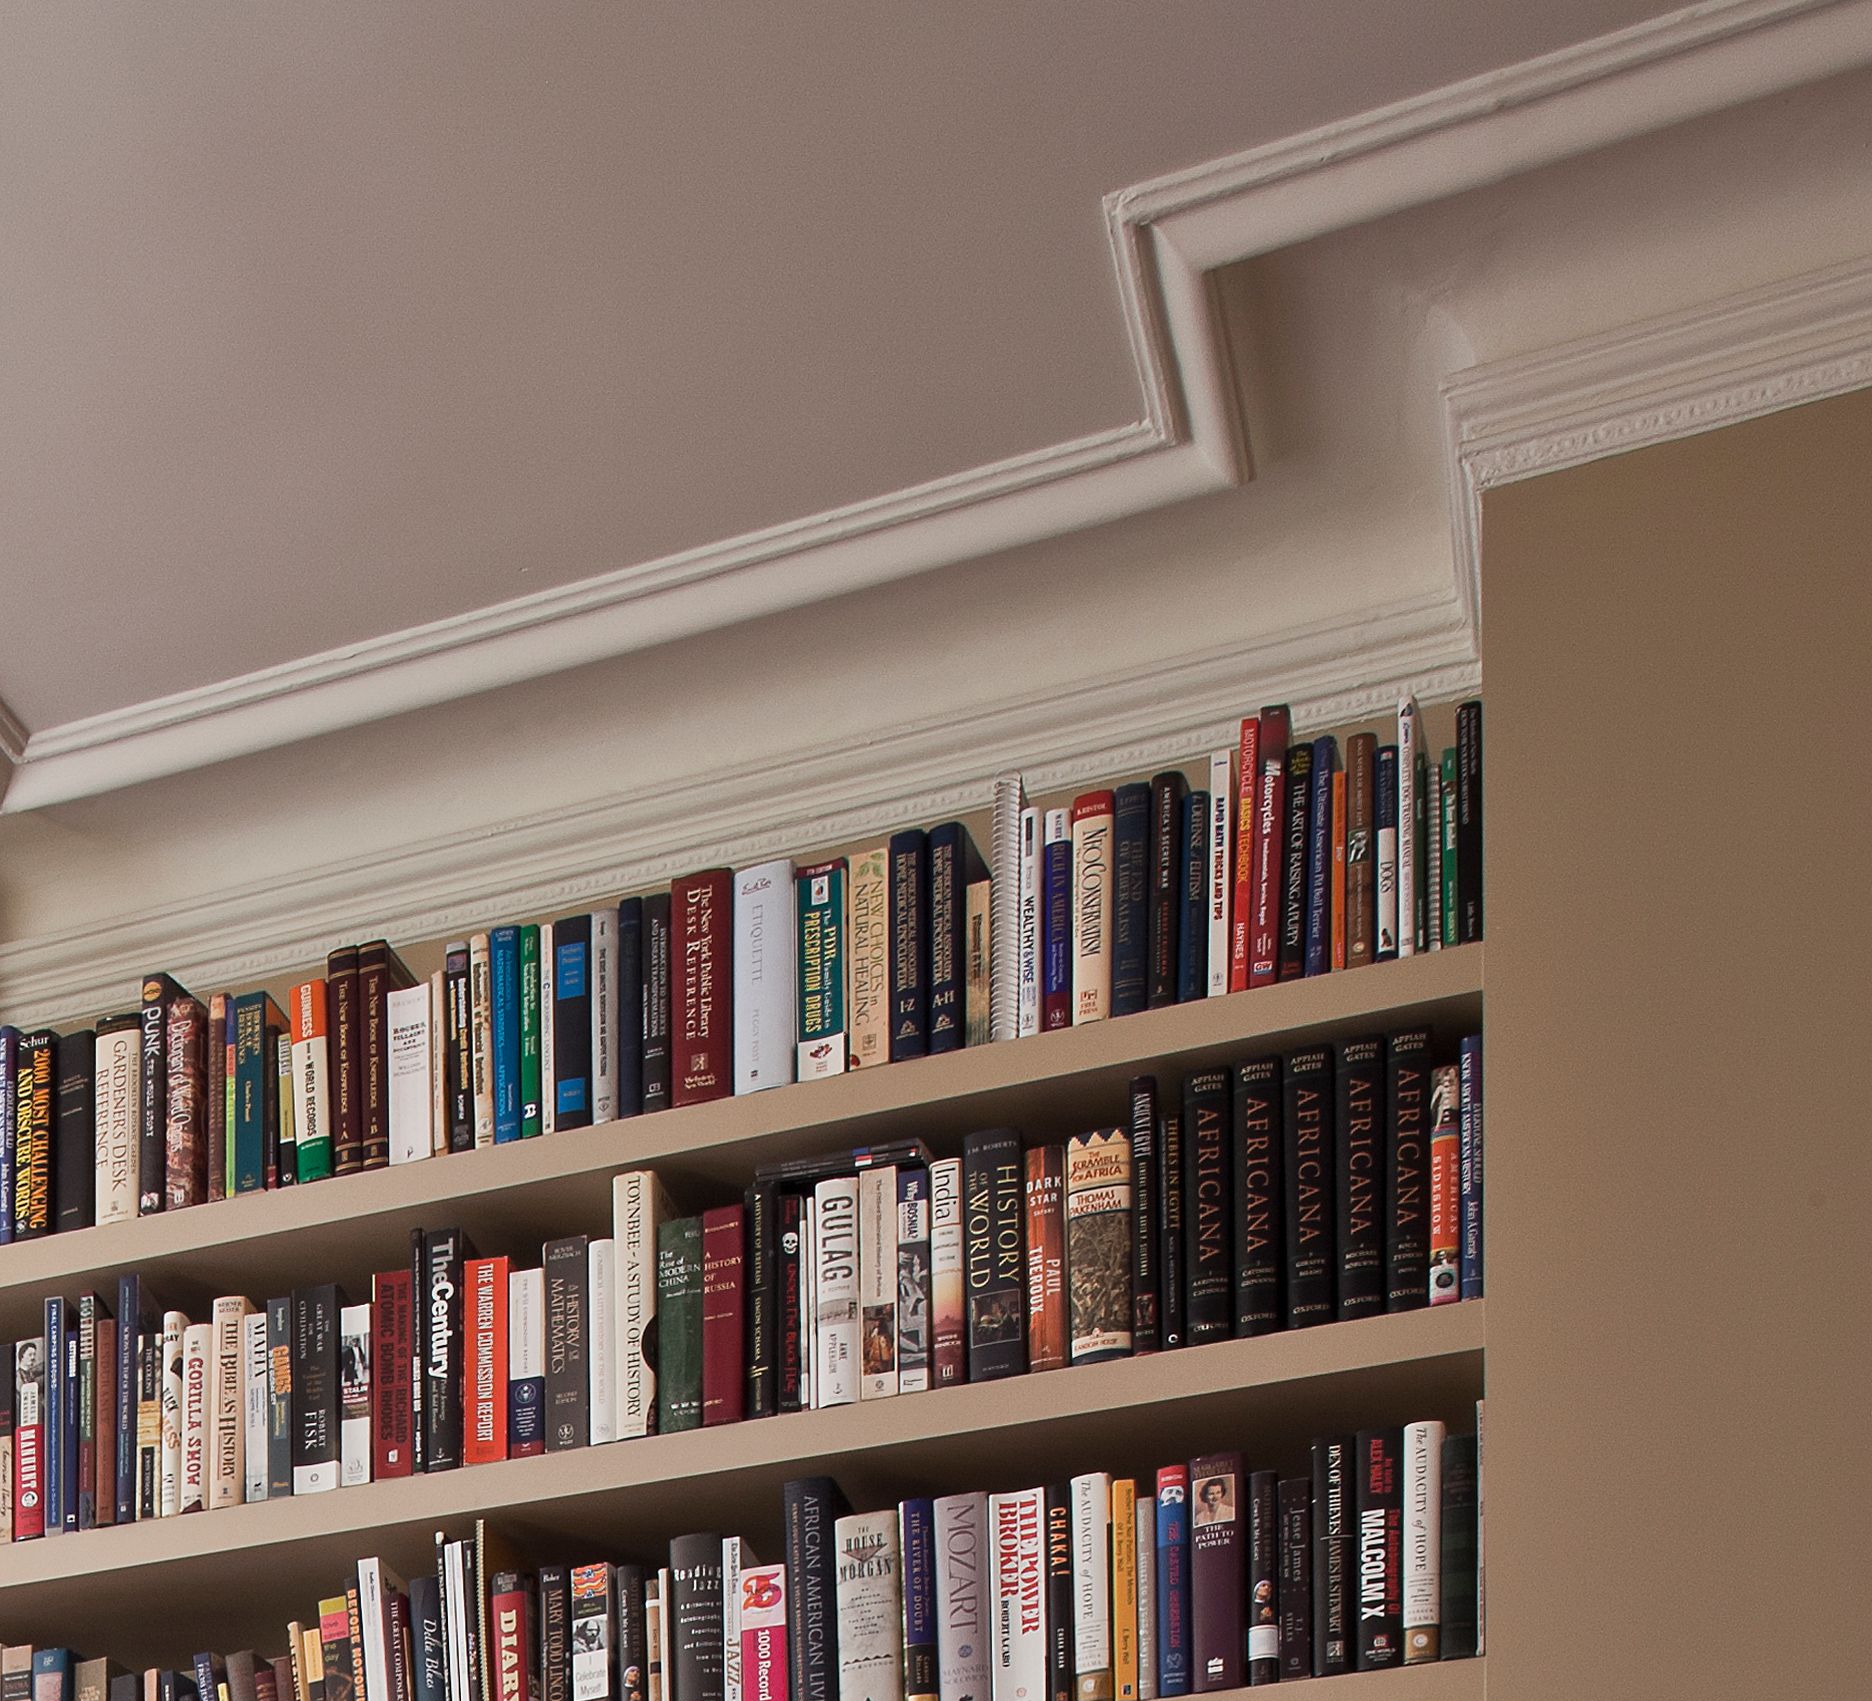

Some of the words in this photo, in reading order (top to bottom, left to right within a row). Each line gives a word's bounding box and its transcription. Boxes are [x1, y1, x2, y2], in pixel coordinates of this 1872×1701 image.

[1262, 760, 1280, 834] Motorcycles
[699, 885, 712, 906] The
[1379, 861, 1393, 893] DOGS
[699, 908, 712, 933] New
[853, 884, 867, 955] NATURAL
[699, 936, 712, 960] York
[803, 913, 819, 991] PRESCRIPTION
[699, 963, 712, 995] Public
[854, 958, 869, 1025] HEALING
[143, 1007, 160, 1059] PUNK
[697, 998, 712, 1037] Library
[804, 996, 820, 1032] DRUGS
[32, 1049, 48, 1085] 2000
[32, 1089, 48, 1127] MOST
[1297, 1088, 1322, 1244] AFRICANA
[1349, 1078, 1372, 1234] AFRICANA
[1396, 1068, 1421, 1225] AFRICANA
[29, 1130, 47, 1228] CHALLENGING
[933, 1167, 955, 1221] India
[1196, 1108, 1220, 1263] AFRICANA
[1246, 1098, 1269, 1253] AFRICANA
[821, 1197, 852, 1281] GULAG
[968, 1189, 989, 1288] WORLD
[995, 1164, 1018, 1283] HISTORY
[477, 1264, 493, 1283] THE
[477, 1286, 492, 1330] WARREN
[477, 1332, 492, 1399] COMMISSION
[187, 1357, 203, 1432] GORILLA
[476, 1402, 492, 1442] REPORT
[185, 1437, 202, 1486] SHOW
[803, 1496, 819, 1568] AFRICAN
[1360, 1510, 1384, 1603] MALCOLM
[947, 1504, 976, 1634] MOZART
[547, 1589, 562, 1626] MARY
[806, 1576, 822, 1668] AMERICAN
[1360, 1605, 1384, 1621] X
[422, 1619, 436, 1654] Delta
[548, 1630, 562, 1661] TODD
[757, 1629, 769, 1659] 1000
[424, 1658, 437, 1689] Blues
[757, 1661, 769, 1699] Record
